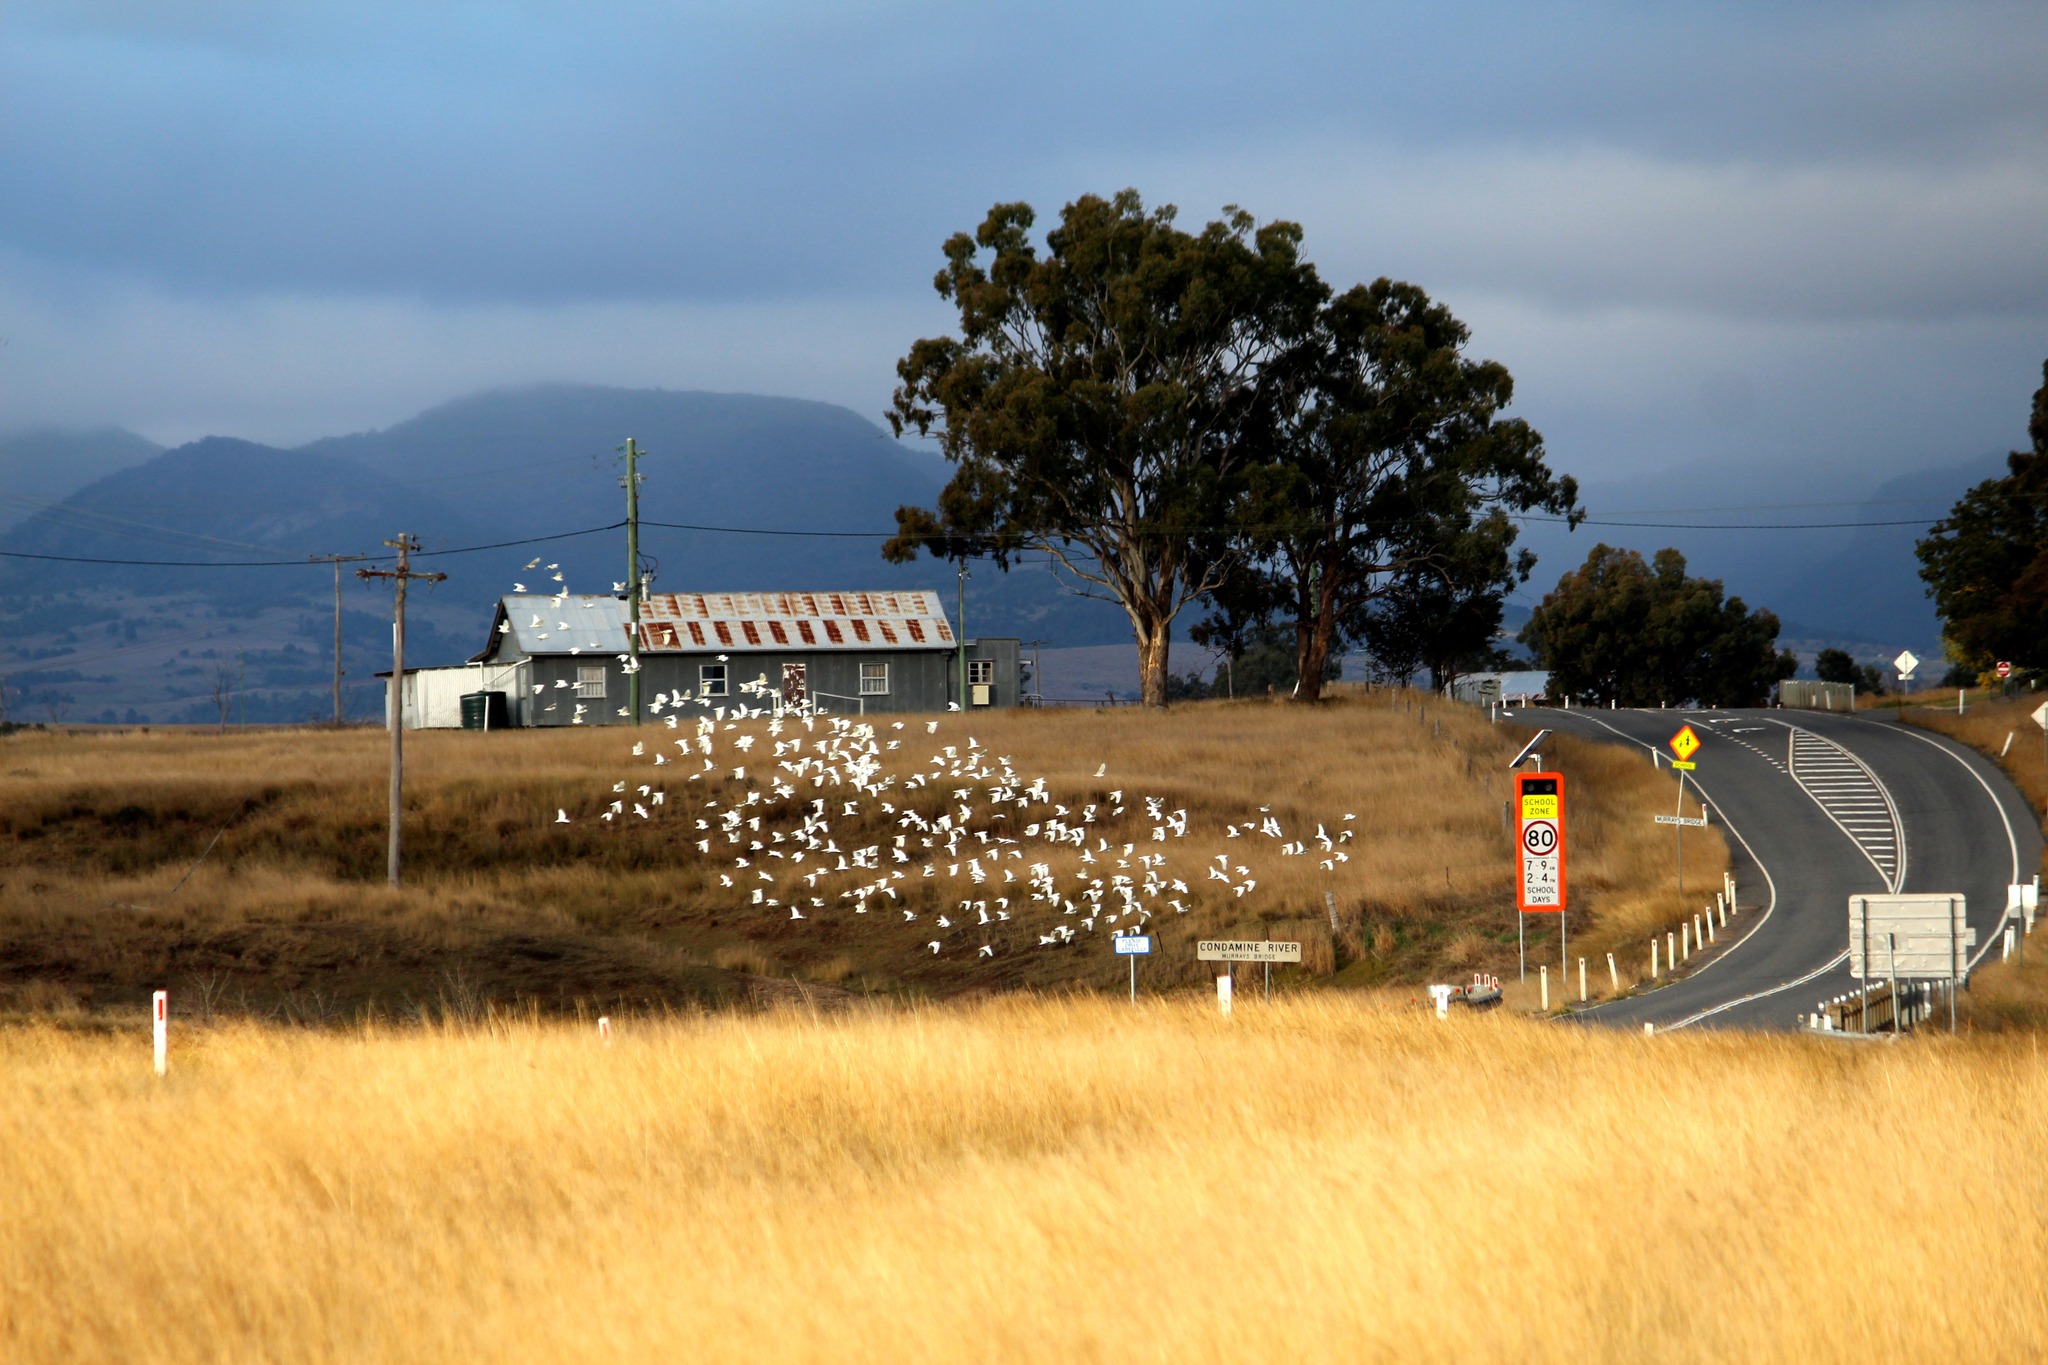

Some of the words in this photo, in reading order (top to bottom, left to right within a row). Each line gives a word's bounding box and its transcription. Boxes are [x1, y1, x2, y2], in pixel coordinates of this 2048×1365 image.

[1524, 798, 1555, 806] SCHOOL
[1656, 816, 1681, 824] MURRAYS
[1528, 829, 1553, 847] 80
[1527, 886, 1556, 894] SCHOOL
[1199, 942, 1260, 953] CONDAMINE
[1268, 944, 1298, 953] RIVER
